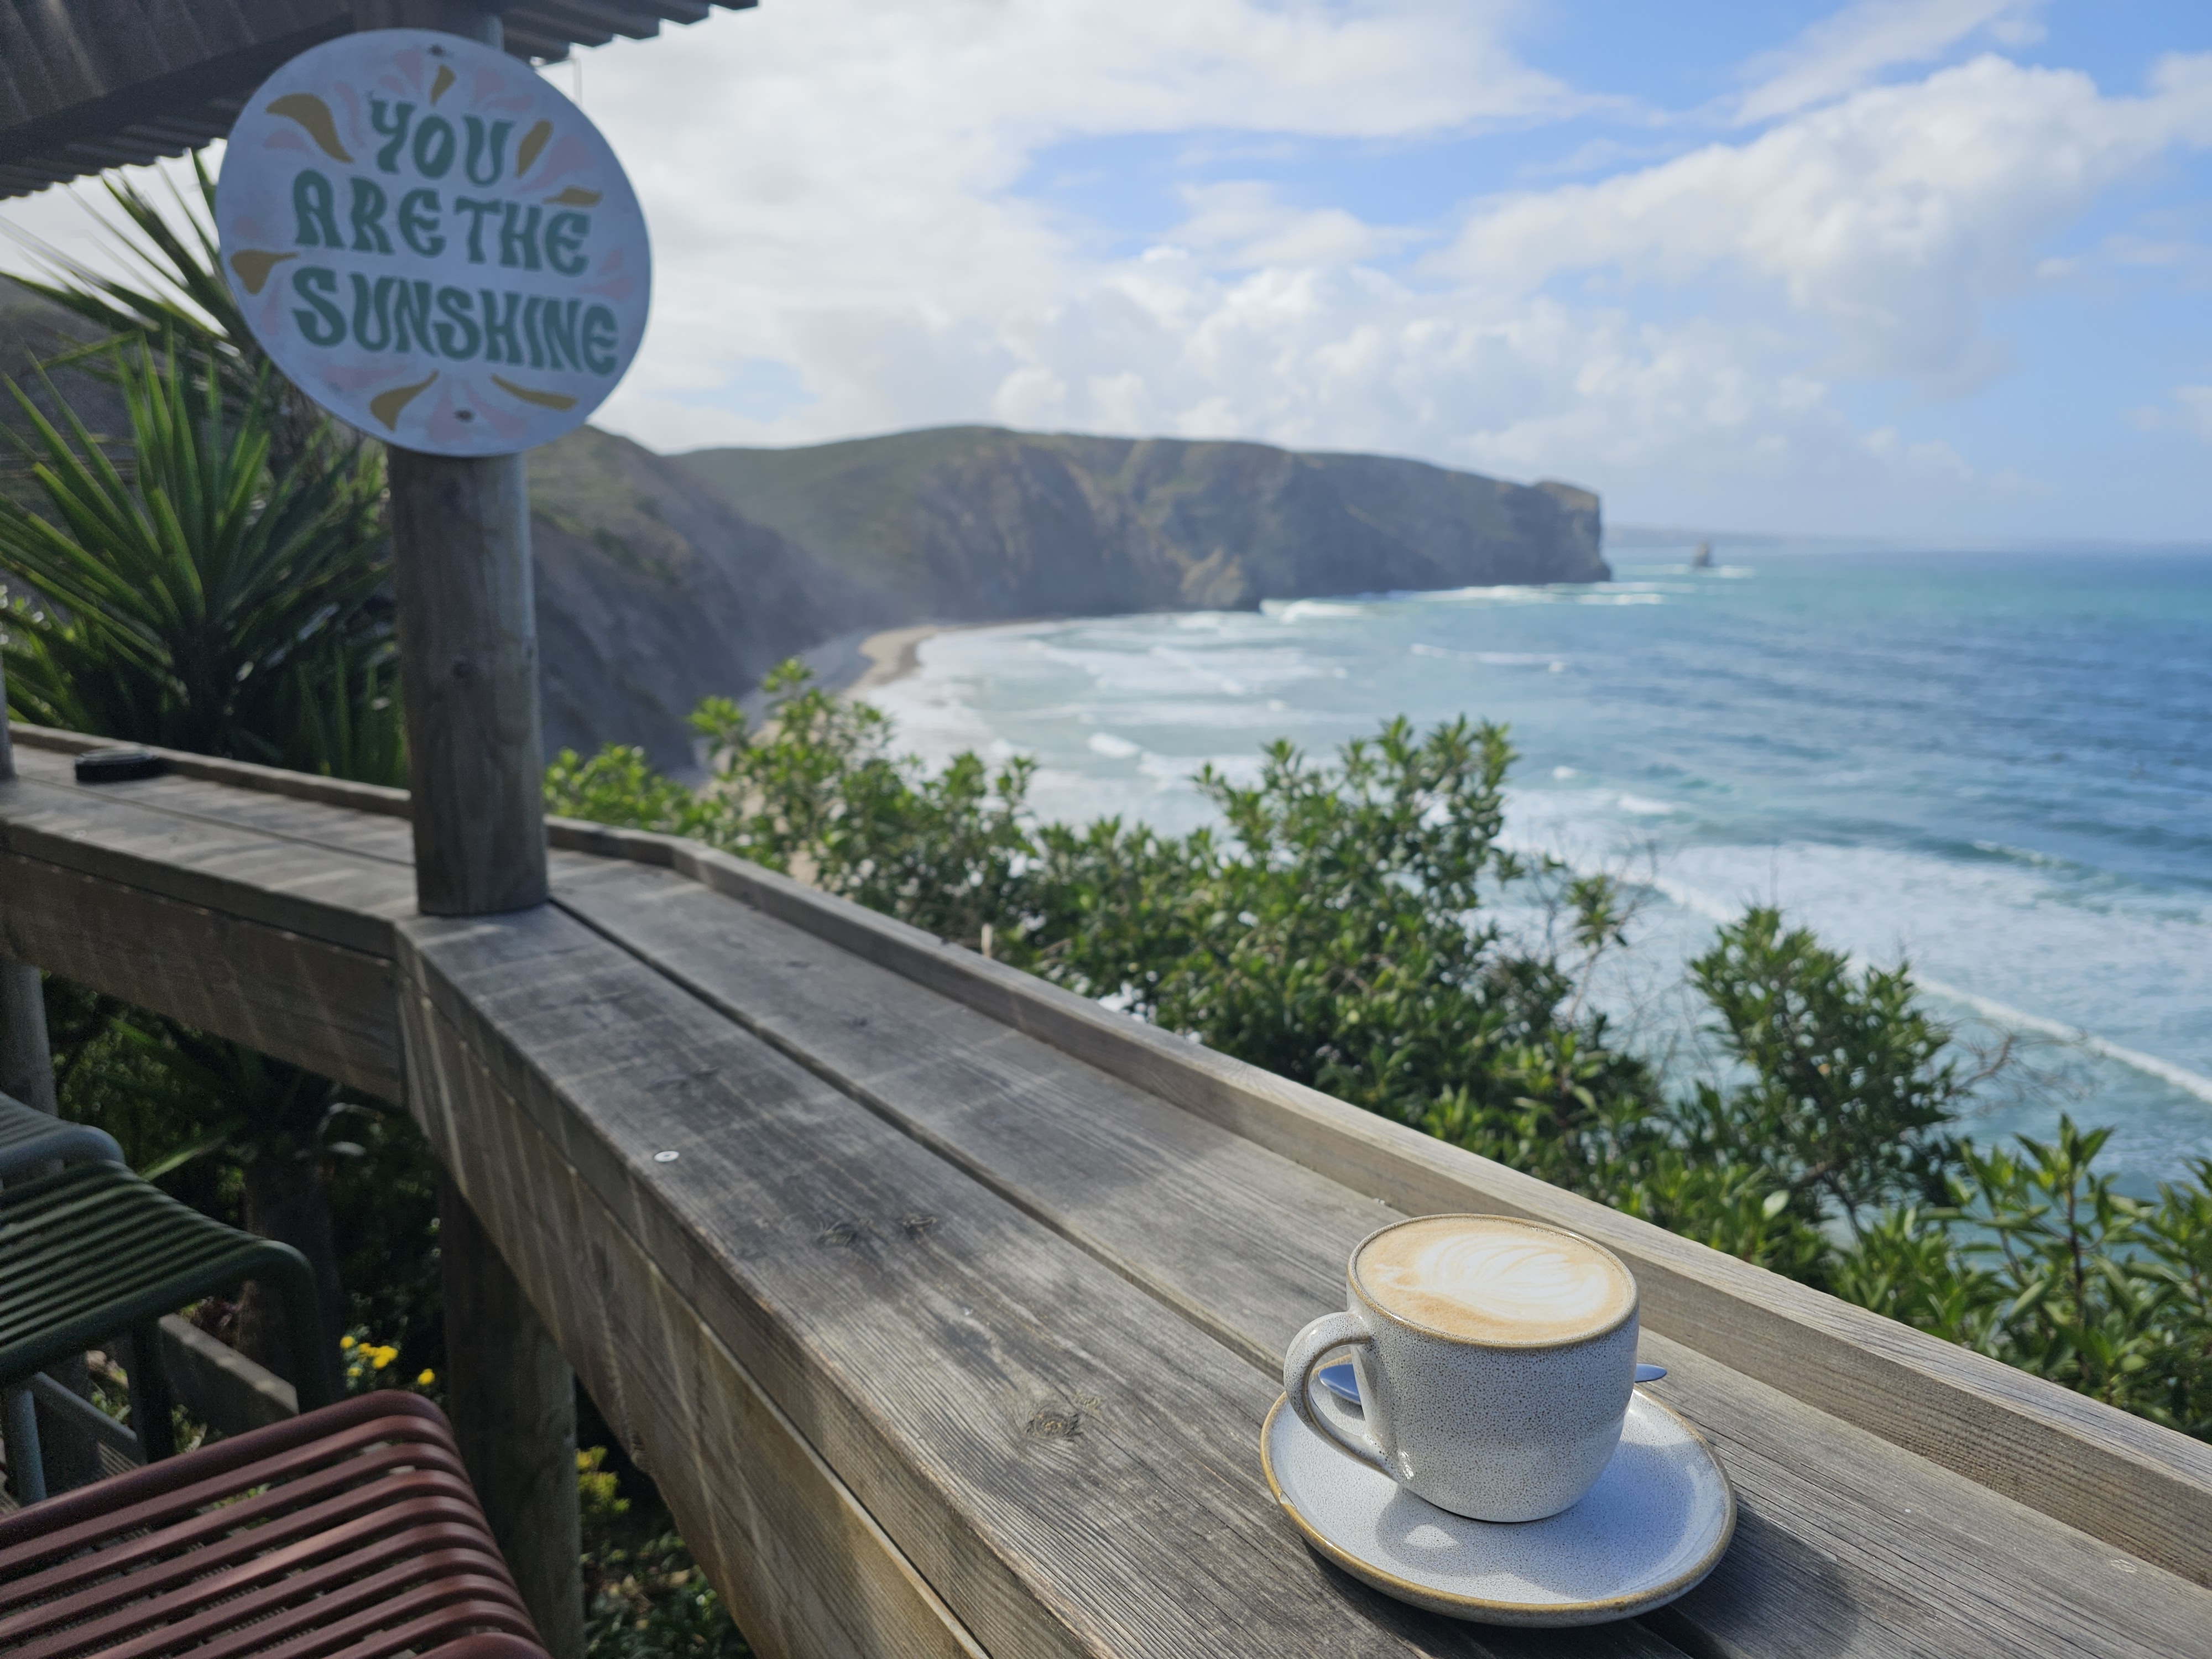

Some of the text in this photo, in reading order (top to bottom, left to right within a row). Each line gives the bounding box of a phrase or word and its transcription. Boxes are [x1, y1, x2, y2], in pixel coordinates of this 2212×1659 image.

[369, 97, 515, 187] YOU
[291, 168, 591, 276] ARE THE
[291, 266, 619, 378] SUNSHINE
